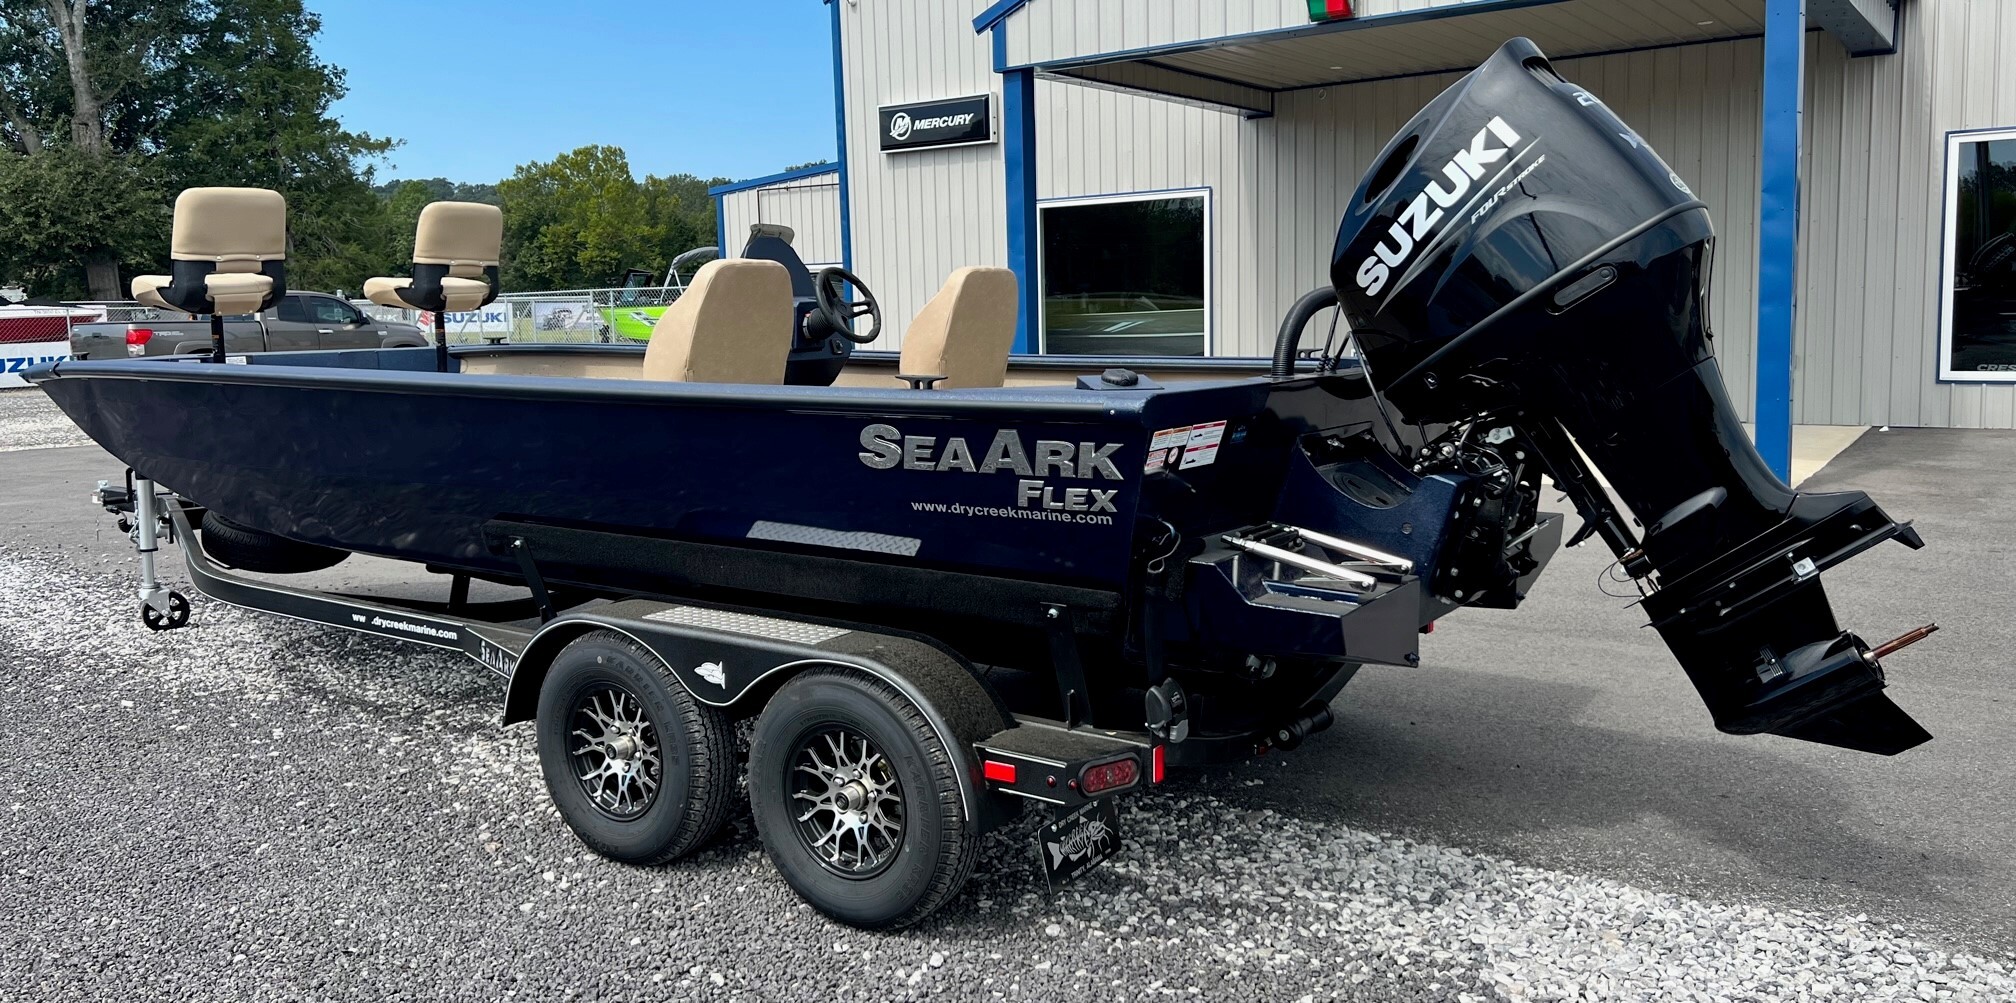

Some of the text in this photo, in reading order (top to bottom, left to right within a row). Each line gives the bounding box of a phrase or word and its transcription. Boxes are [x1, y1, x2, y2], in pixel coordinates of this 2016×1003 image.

[913, 113, 974, 130] MERCURY
[1356, 115, 1521, 297] SUZUKI
[443, 312, 507, 324] SUZUKI
[1017, 479, 1118, 513] FLEX
[911, 502, 1113, 526] www.drycreekmarine.com
